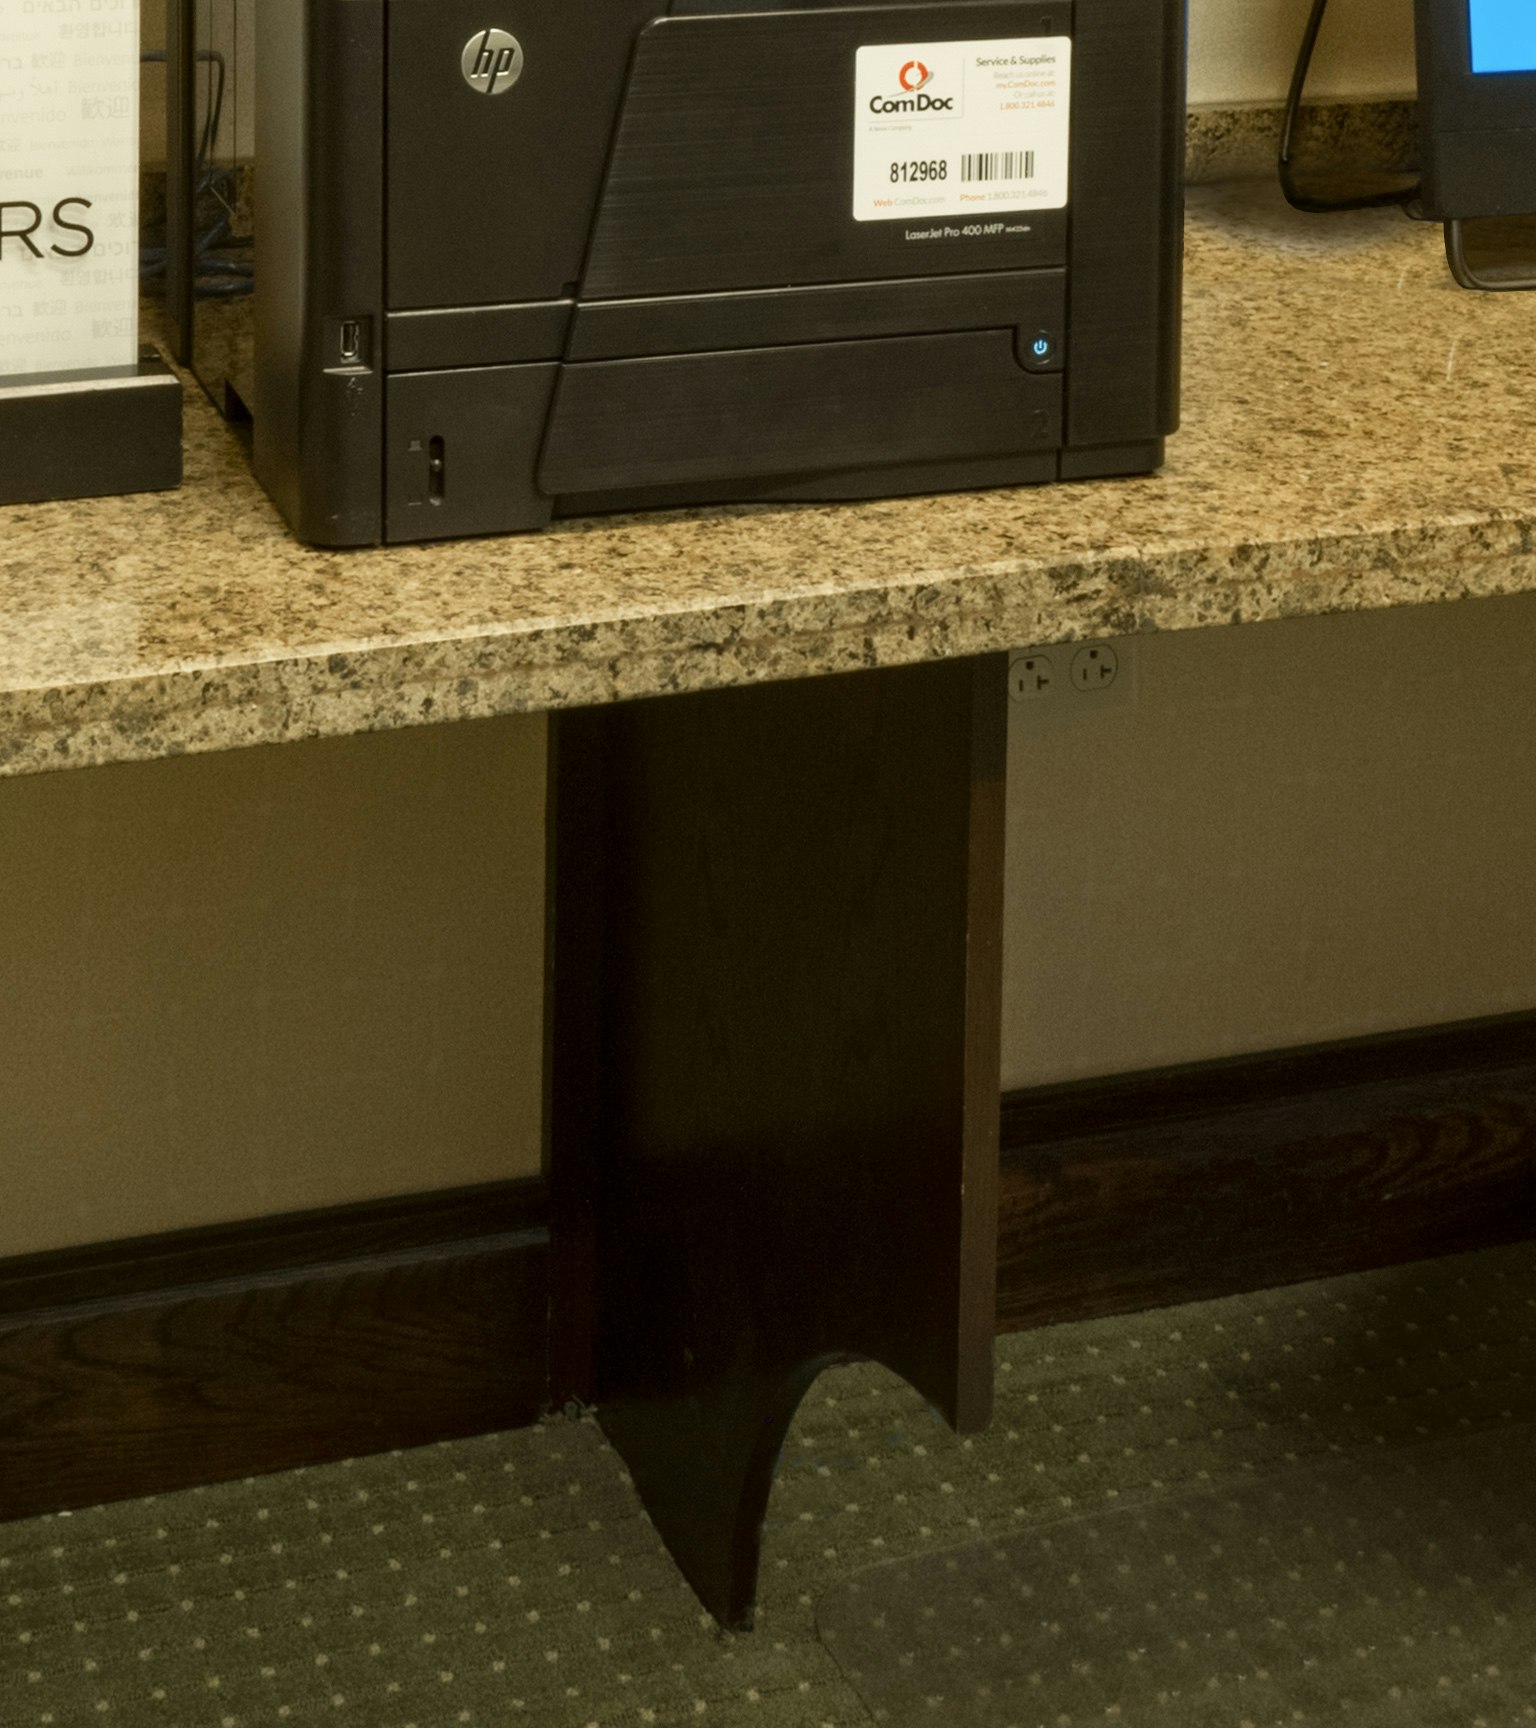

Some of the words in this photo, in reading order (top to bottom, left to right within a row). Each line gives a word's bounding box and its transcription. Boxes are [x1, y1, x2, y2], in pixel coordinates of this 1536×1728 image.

[468, 29, 517, 95] hp
[976, 56, 1008, 68] Service
[1010, 55, 1017, 65] &
[1019, 54, 1056, 66] Supplies
[996, 80, 1056, 90] my.ComDoc.com
[869, 93, 954, 114] ComDoc
[890, 159, 948, 183] 812968
[873, 198, 893, 208] Web
[959, 192, 985, 204] Phone
[905, 228, 942, 241] LaserJet
[944, 226, 960, 238] Pro
[962, 224, 983, 237] 400
[984, 222, 1005, 235] MFP
